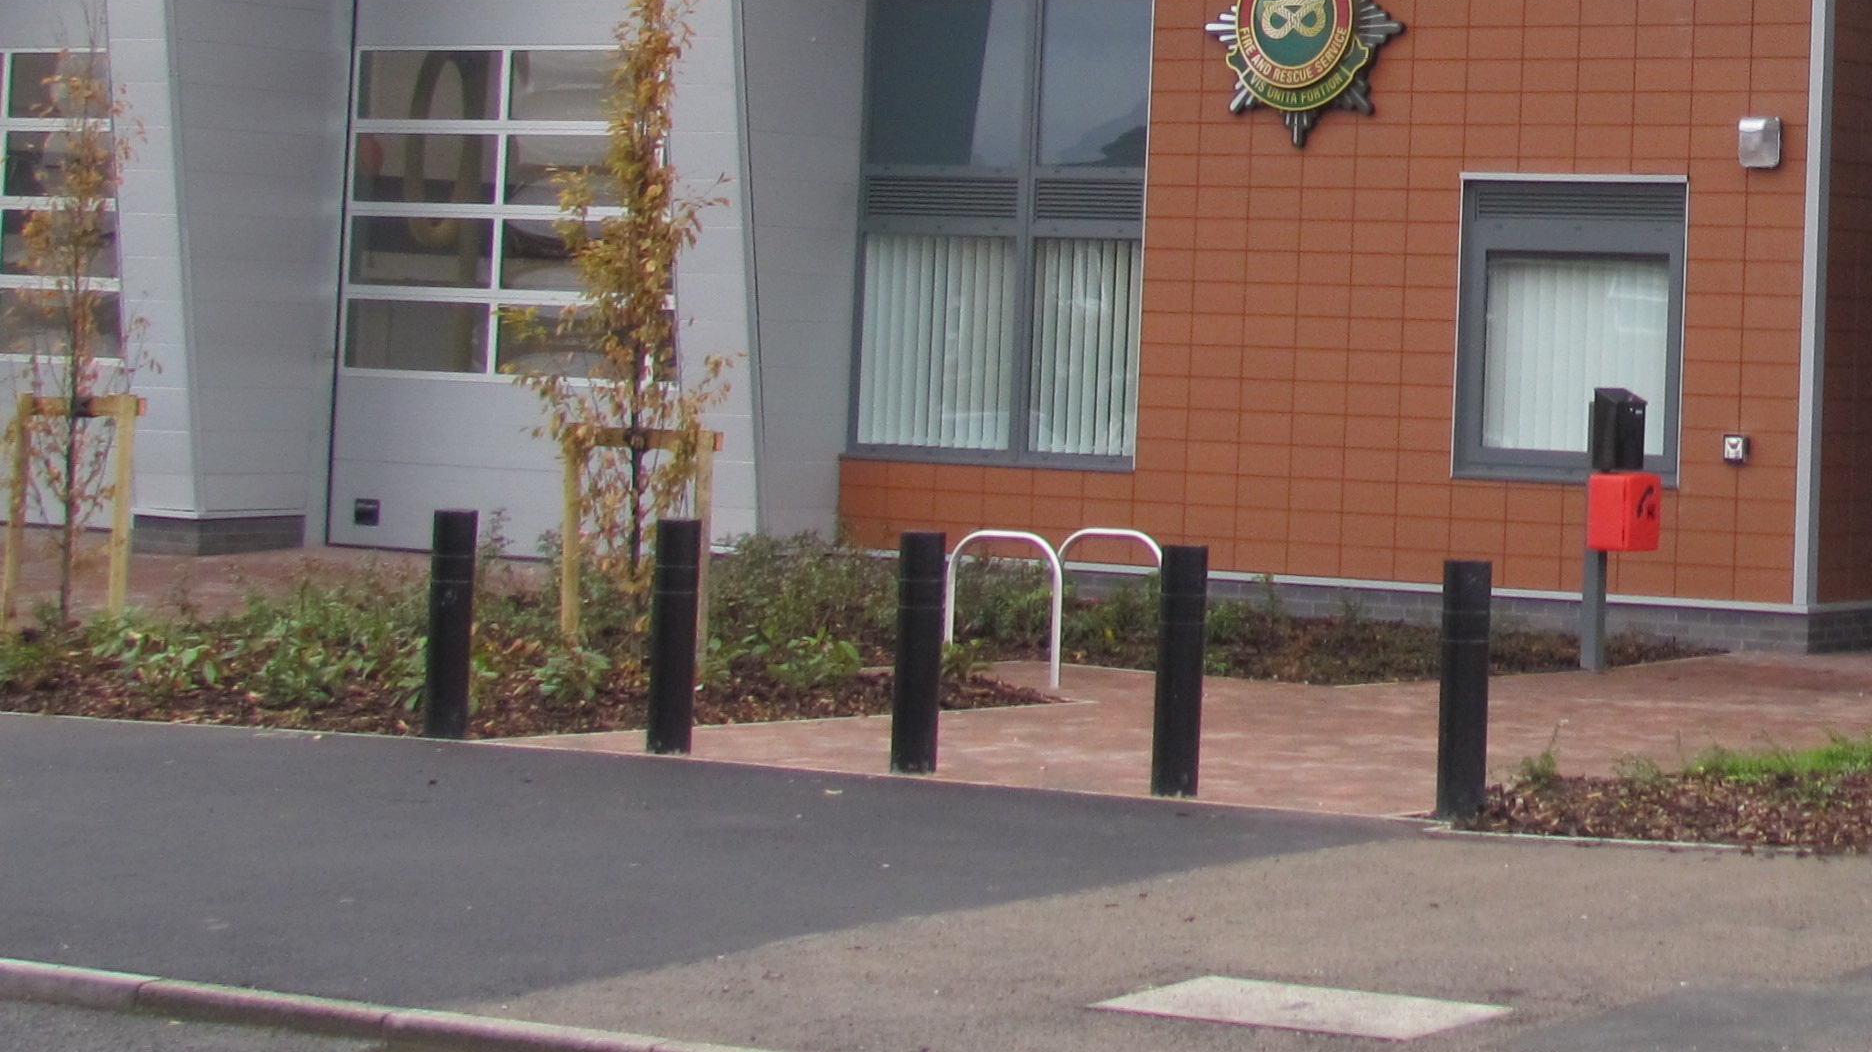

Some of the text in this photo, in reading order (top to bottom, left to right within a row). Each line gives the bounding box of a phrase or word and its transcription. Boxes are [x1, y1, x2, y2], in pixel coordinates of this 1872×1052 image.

[1239, 26, 1348, 82] FIRE AND RESCUE SERVICE
[1250, 74, 1265, 92] VIS
[1267, 88, 1297, 105] UNITA
